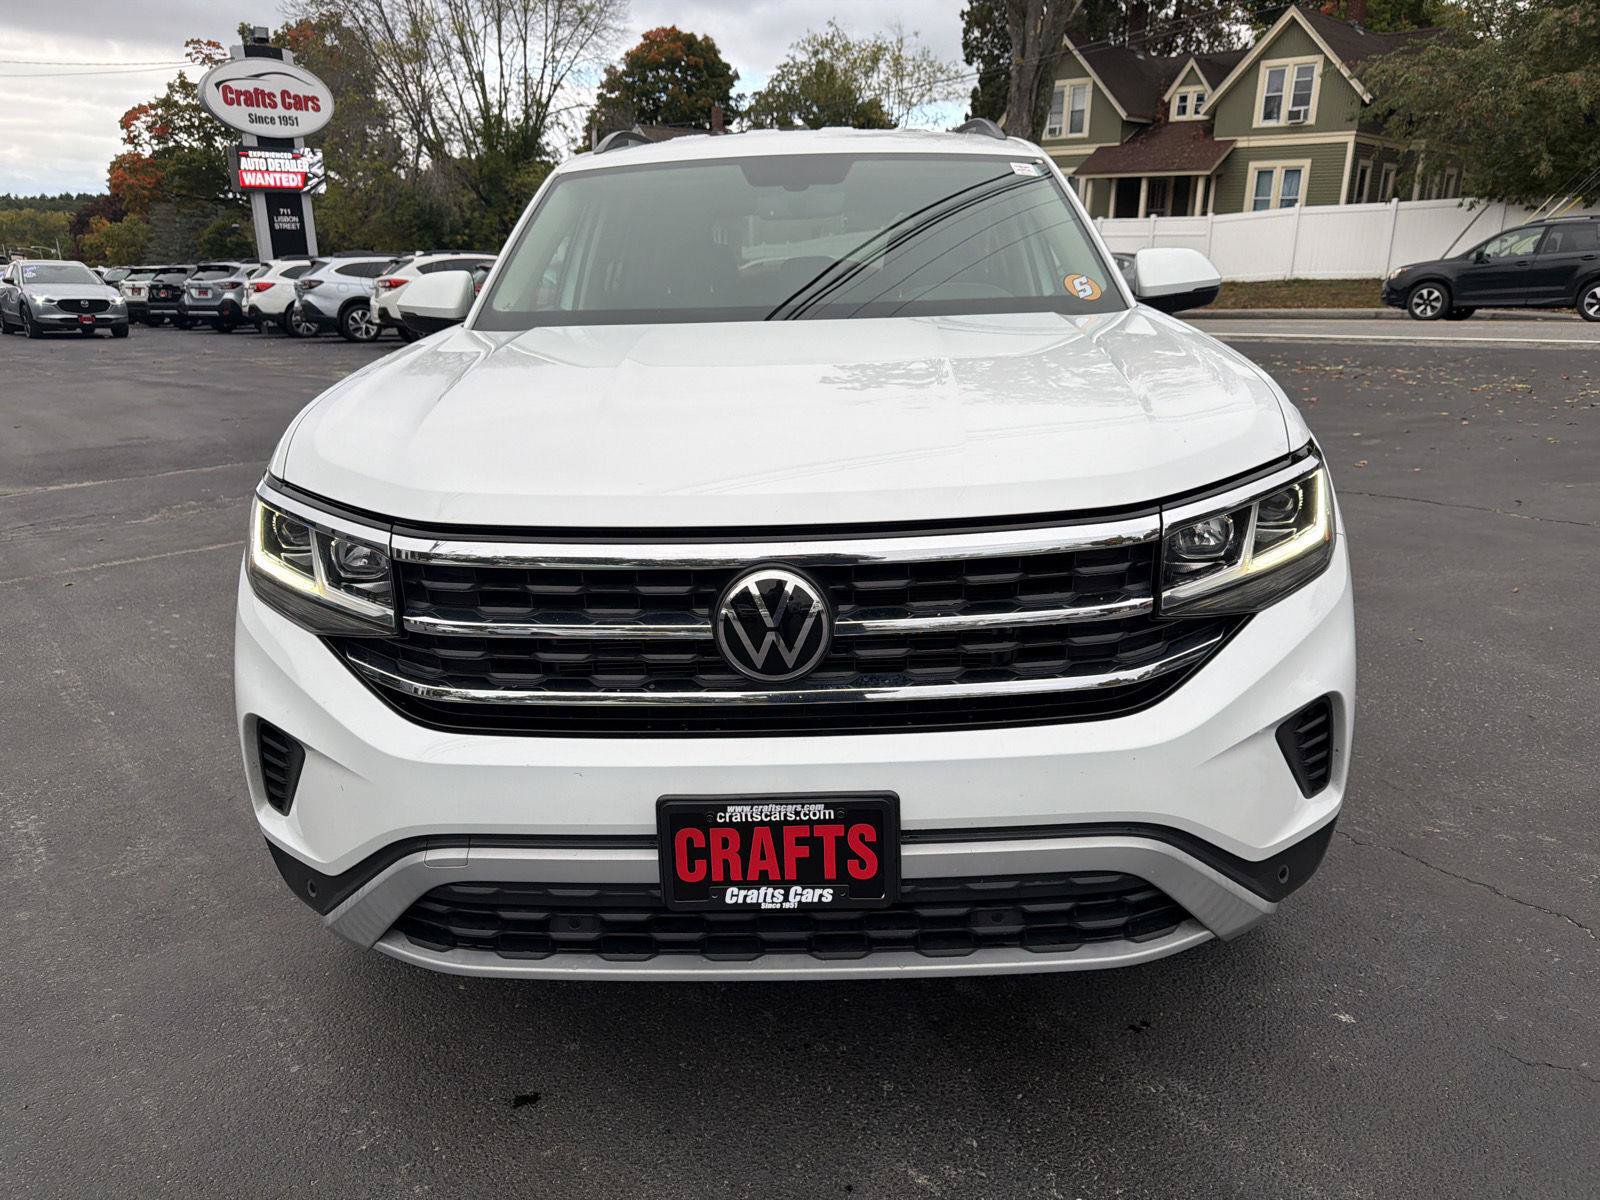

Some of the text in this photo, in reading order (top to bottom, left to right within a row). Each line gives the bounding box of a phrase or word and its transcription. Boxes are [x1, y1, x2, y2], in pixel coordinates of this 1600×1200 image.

[221, 84, 321, 112] Crafts Cars
[248, 113, 299, 127] Since 1951
[240, 157, 309, 172] AUTO DETAILER
[241, 171, 302, 187] WANTED!
[274, 222, 300, 231] STREET
[716, 808, 835, 823] craftscars.com
[674, 823, 879, 883] CRAFTS
[725, 885, 833, 904] Crafts Cars
